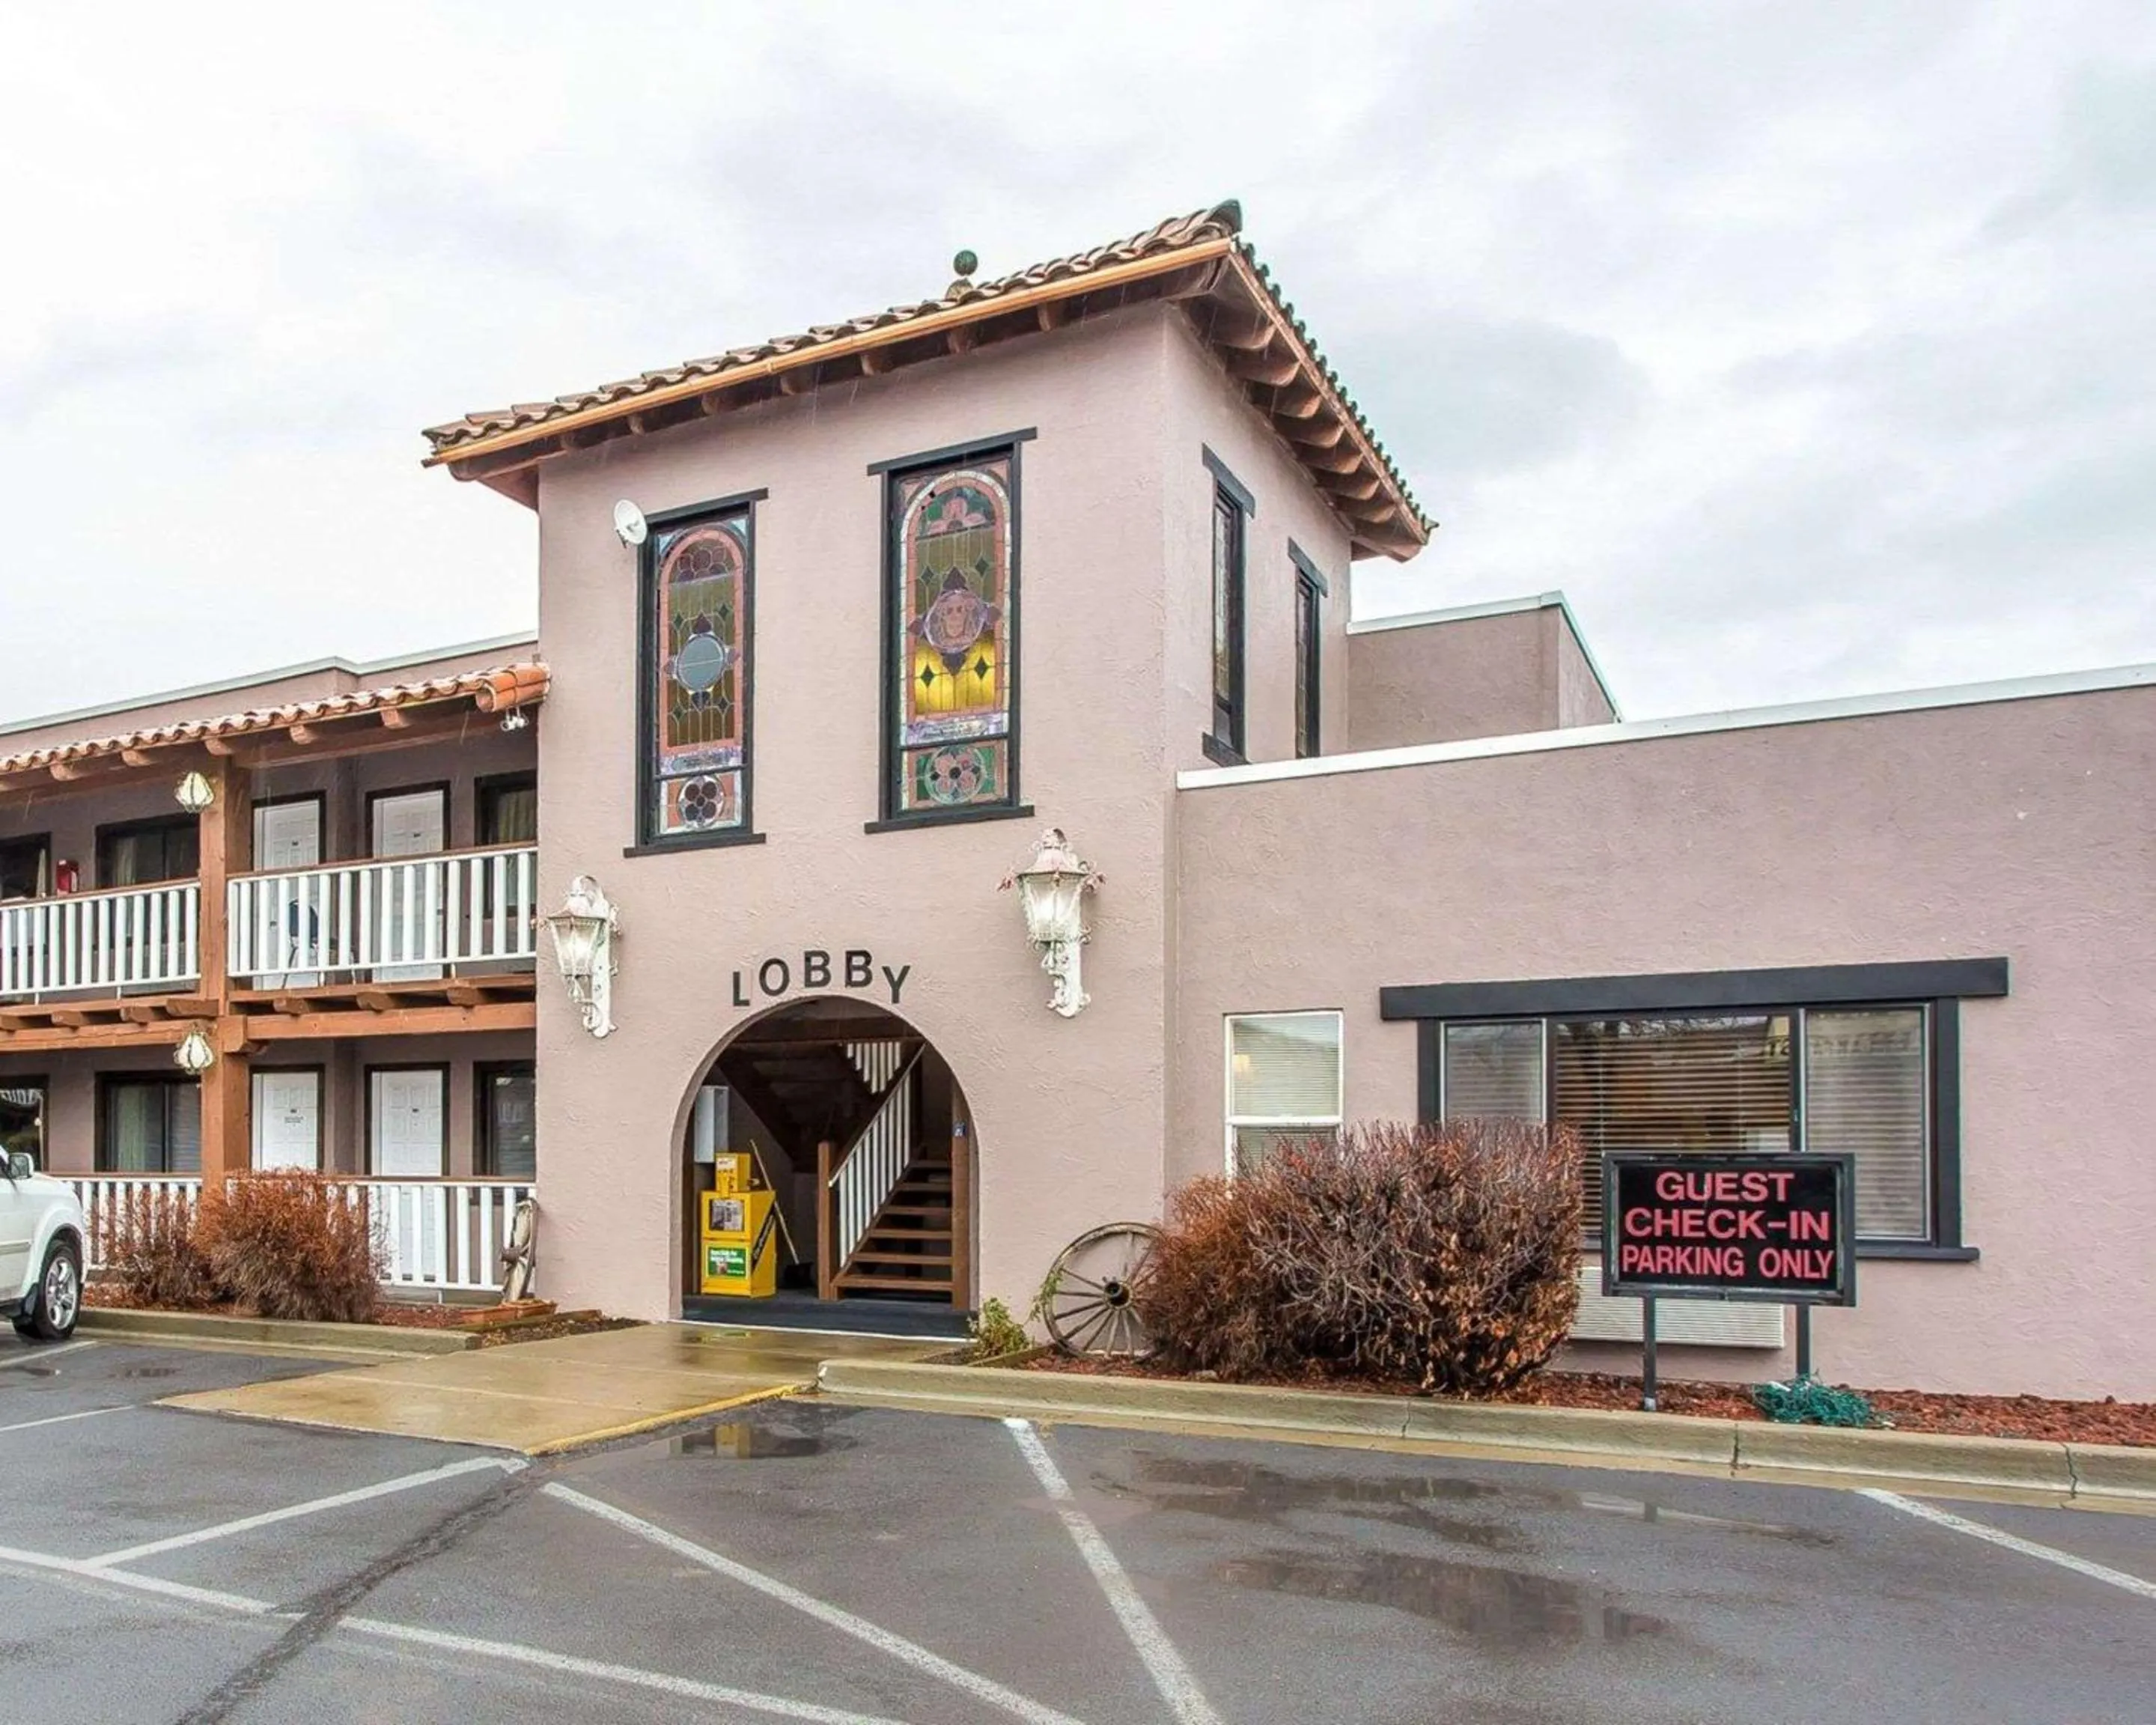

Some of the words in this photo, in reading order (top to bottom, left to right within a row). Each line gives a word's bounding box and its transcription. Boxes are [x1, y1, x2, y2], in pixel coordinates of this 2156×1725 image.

[732, 949, 911, 1007] LOBBY
[1655, 1171, 1795, 1202] GUEST
[1624, 1208, 1830, 1241] CHECK-IN
[1621, 1244, 1744, 1277] PARKING
[1758, 1247, 1834, 1280] ONLY
